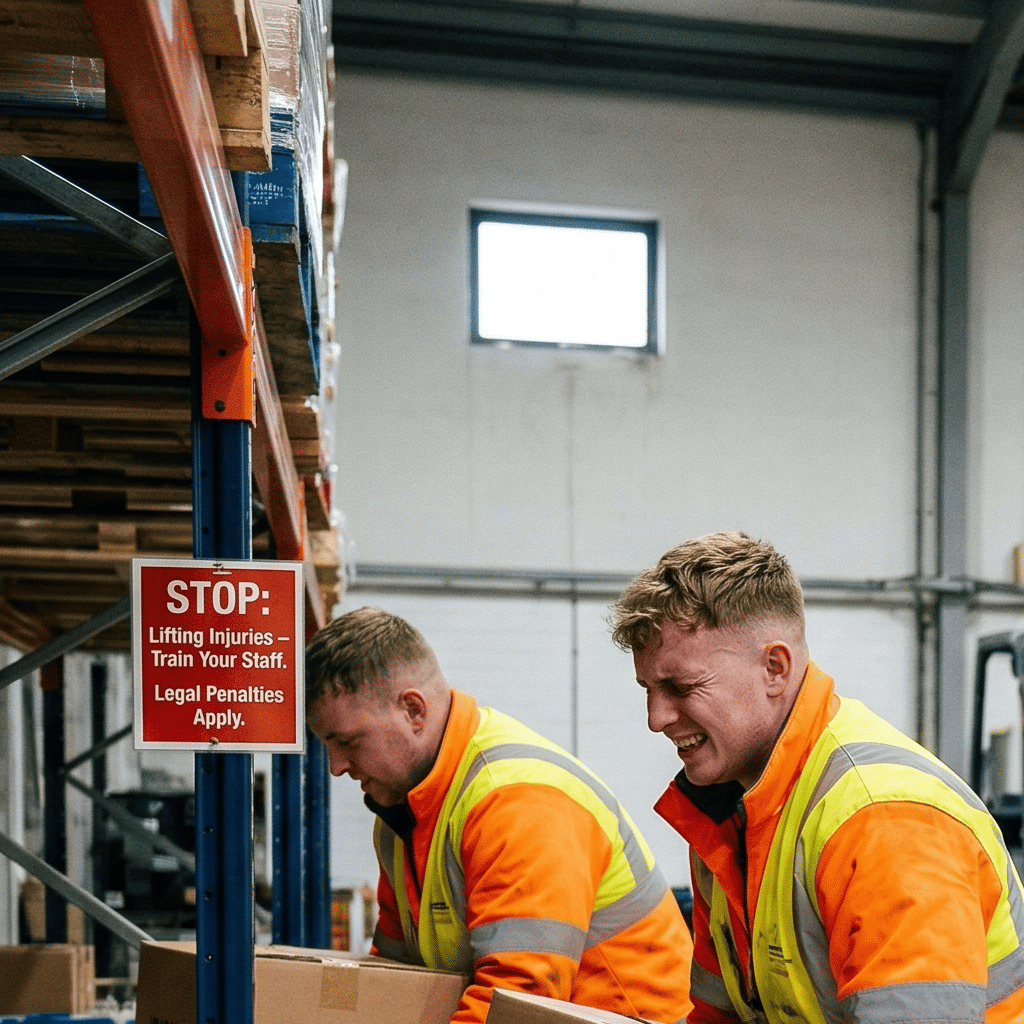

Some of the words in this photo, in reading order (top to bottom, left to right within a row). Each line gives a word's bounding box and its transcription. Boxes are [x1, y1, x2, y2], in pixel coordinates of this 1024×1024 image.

[166, 580, 270, 616] STOP:
[149, 626, 204, 648] Lifting
[209, 628, 274, 649] Injuries
[151, 650, 194, 667] Train
[199, 650, 237, 668] Your
[241, 651, 288, 669] Staff.
[154, 684, 201, 706] Legal
[206, 685, 285, 704] Penalties
[193, 708, 246, 730] Apply.
